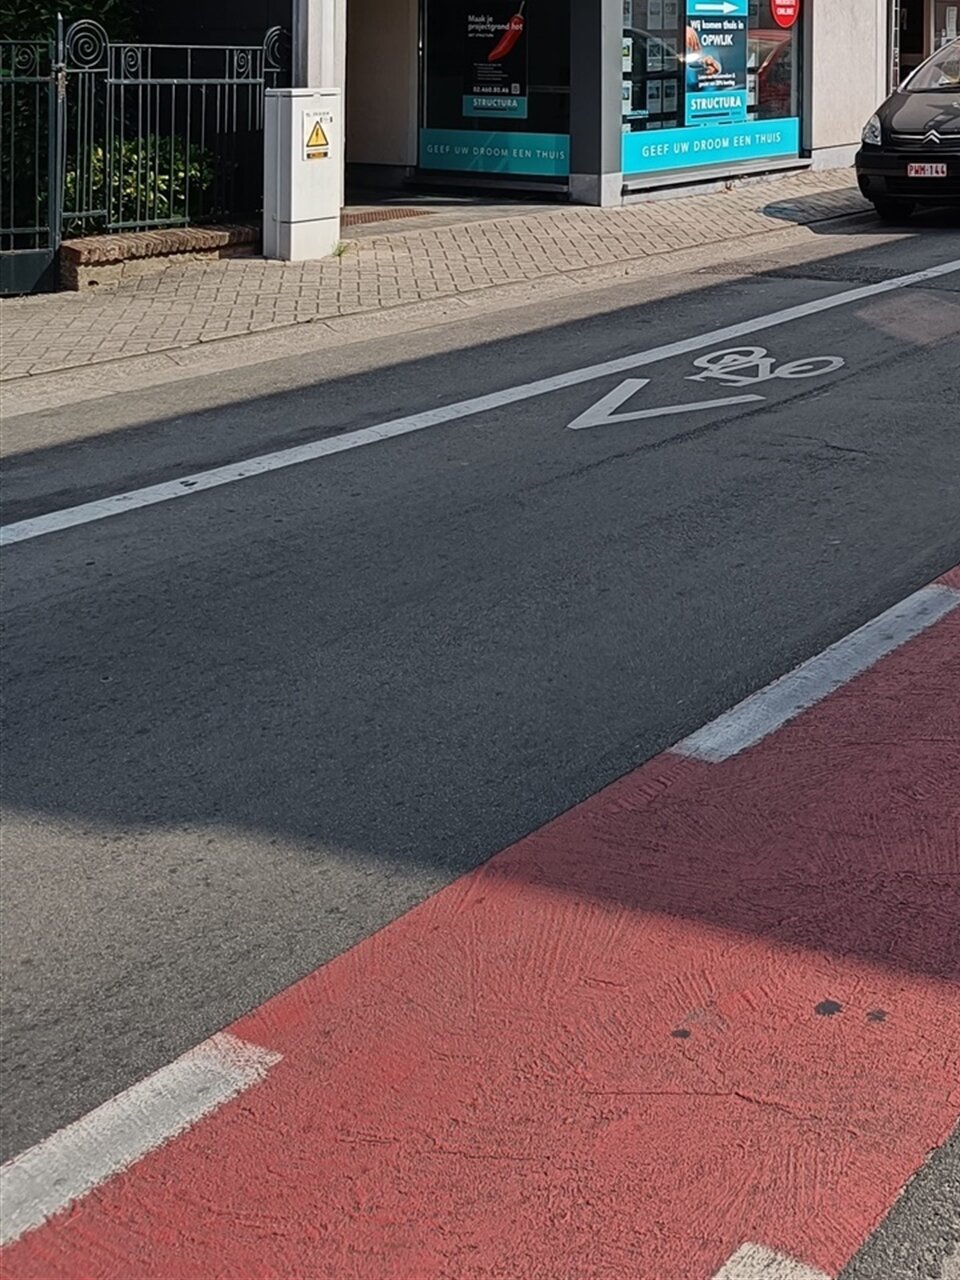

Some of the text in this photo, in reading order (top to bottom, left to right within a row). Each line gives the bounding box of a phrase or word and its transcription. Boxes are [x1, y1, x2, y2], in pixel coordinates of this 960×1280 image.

[467, 14, 493, 24] Maak je
[467, 22, 523, 32] projectgrond hot
[690, 20, 744, 31] Wij komen thuis in
[701, 34, 734, 46] OPWIJK
[473, 98, 518, 108] STRUCTURA
[690, 96, 742, 110] STRUCTURA
[641, 131, 781, 157] GEEF UW DROOM EEN THUIS
[426, 144, 565, 160] GEEF UW DROOM EEN THUIS
